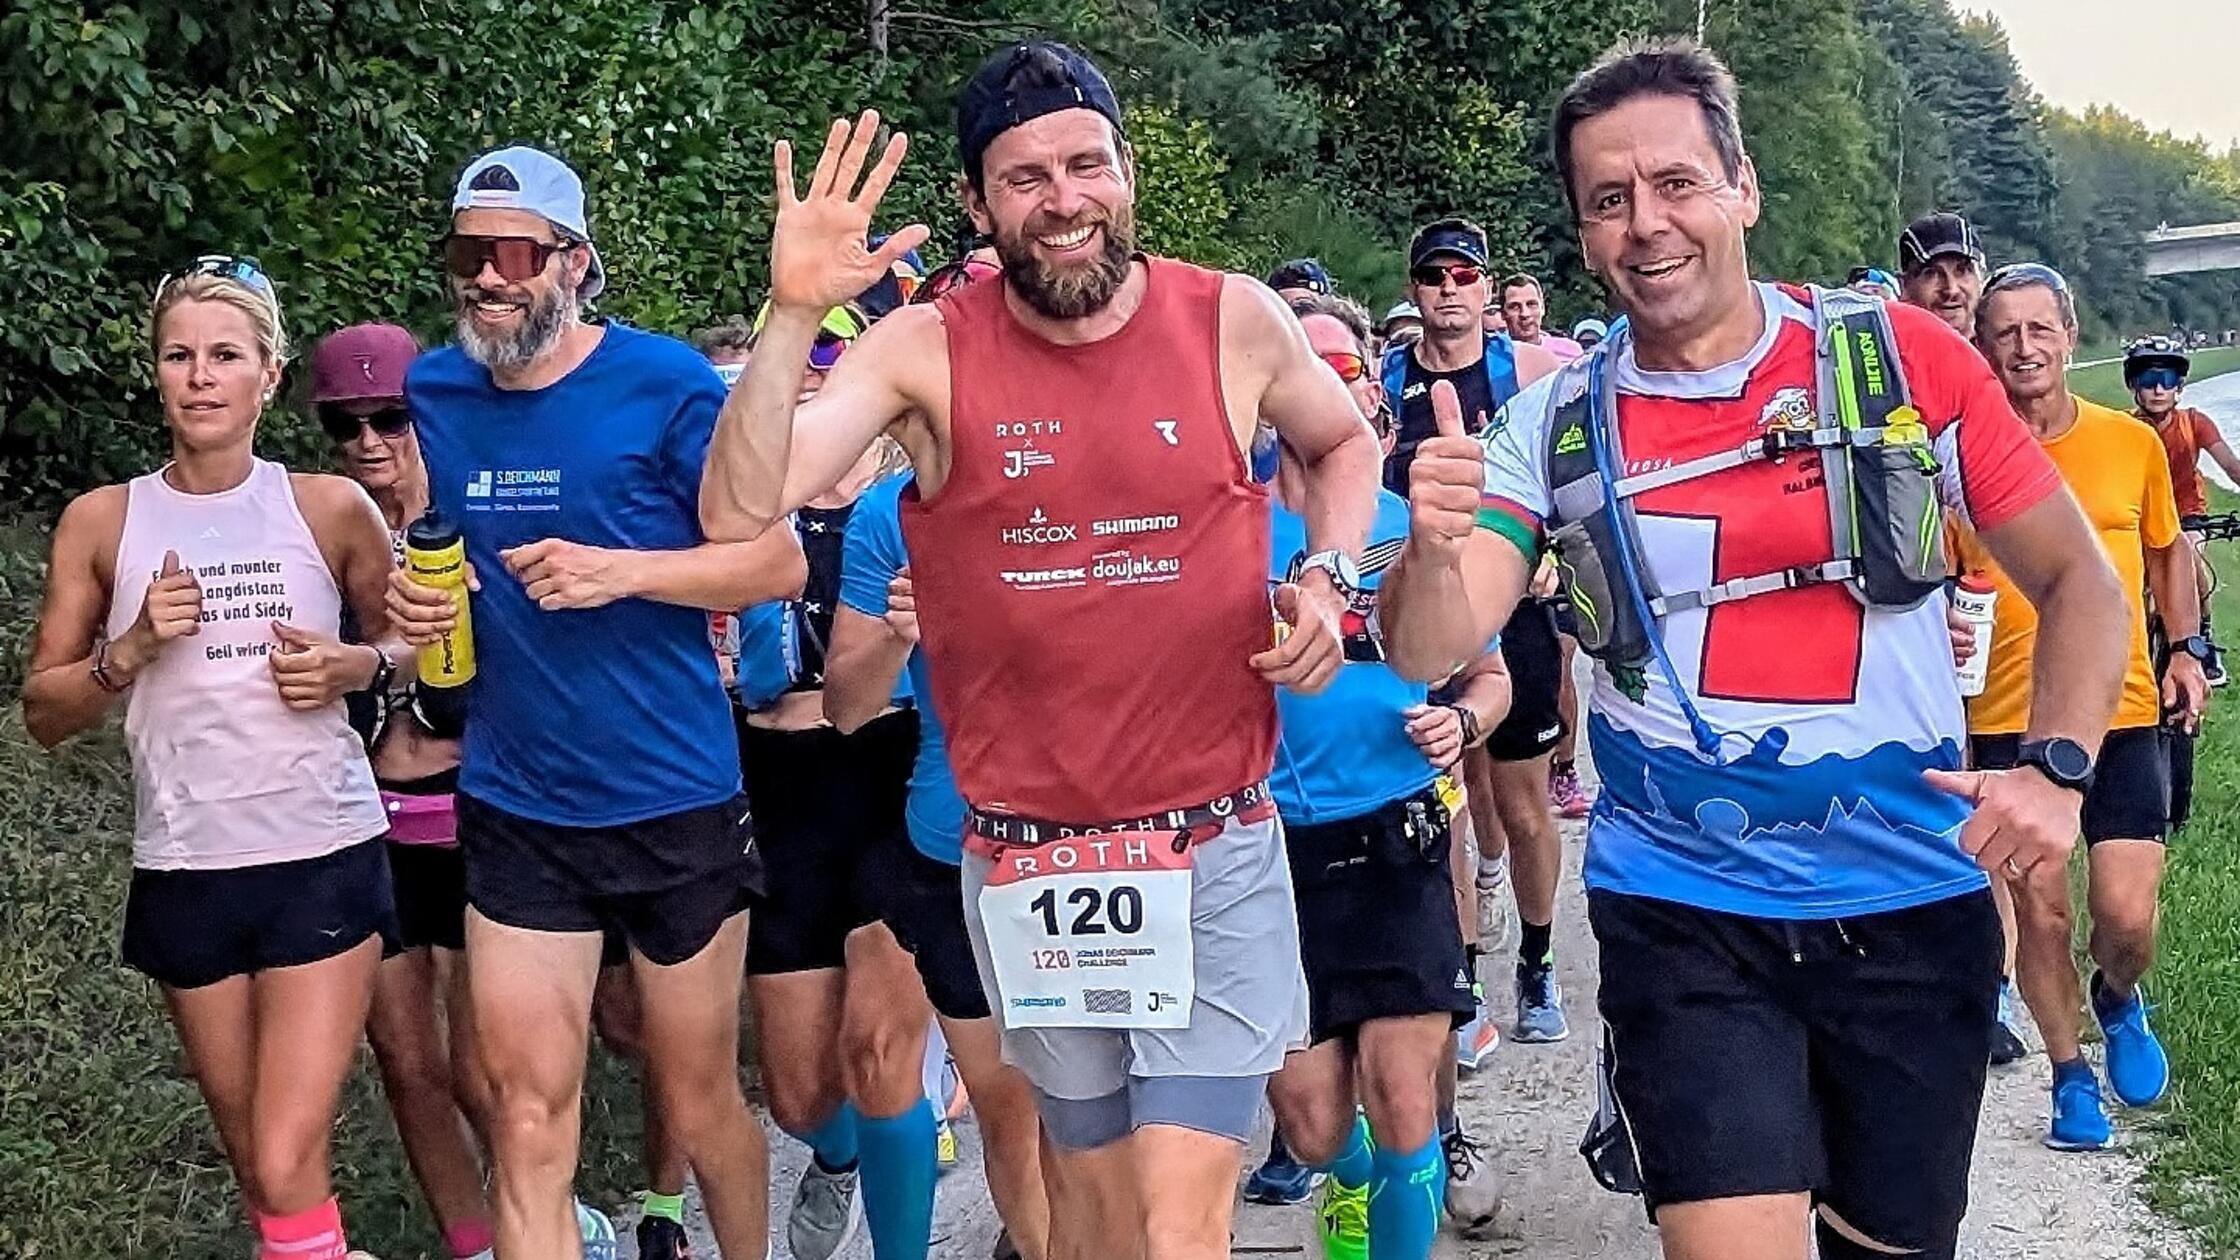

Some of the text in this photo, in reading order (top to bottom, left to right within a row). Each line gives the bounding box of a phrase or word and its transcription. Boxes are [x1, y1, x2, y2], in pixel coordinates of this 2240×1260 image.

[996, 421, 1062, 437] ROTH
[1002, 515, 1179, 544] HISCOX SHIMANO
[199, 563, 226, 578] und
[231, 560, 282, 576] munter
[1000, 567, 1087, 583] TURCK
[1093, 555, 1180, 580] doujak.eu
[224, 603, 250, 619] und
[255, 602, 293, 621] Siddy
[206, 642, 276, 660] Geil wird'
[1015, 840, 1147, 876] ROTH
[1031, 886, 1143, 936] 120
[1032, 949, 1071, 970] 120
